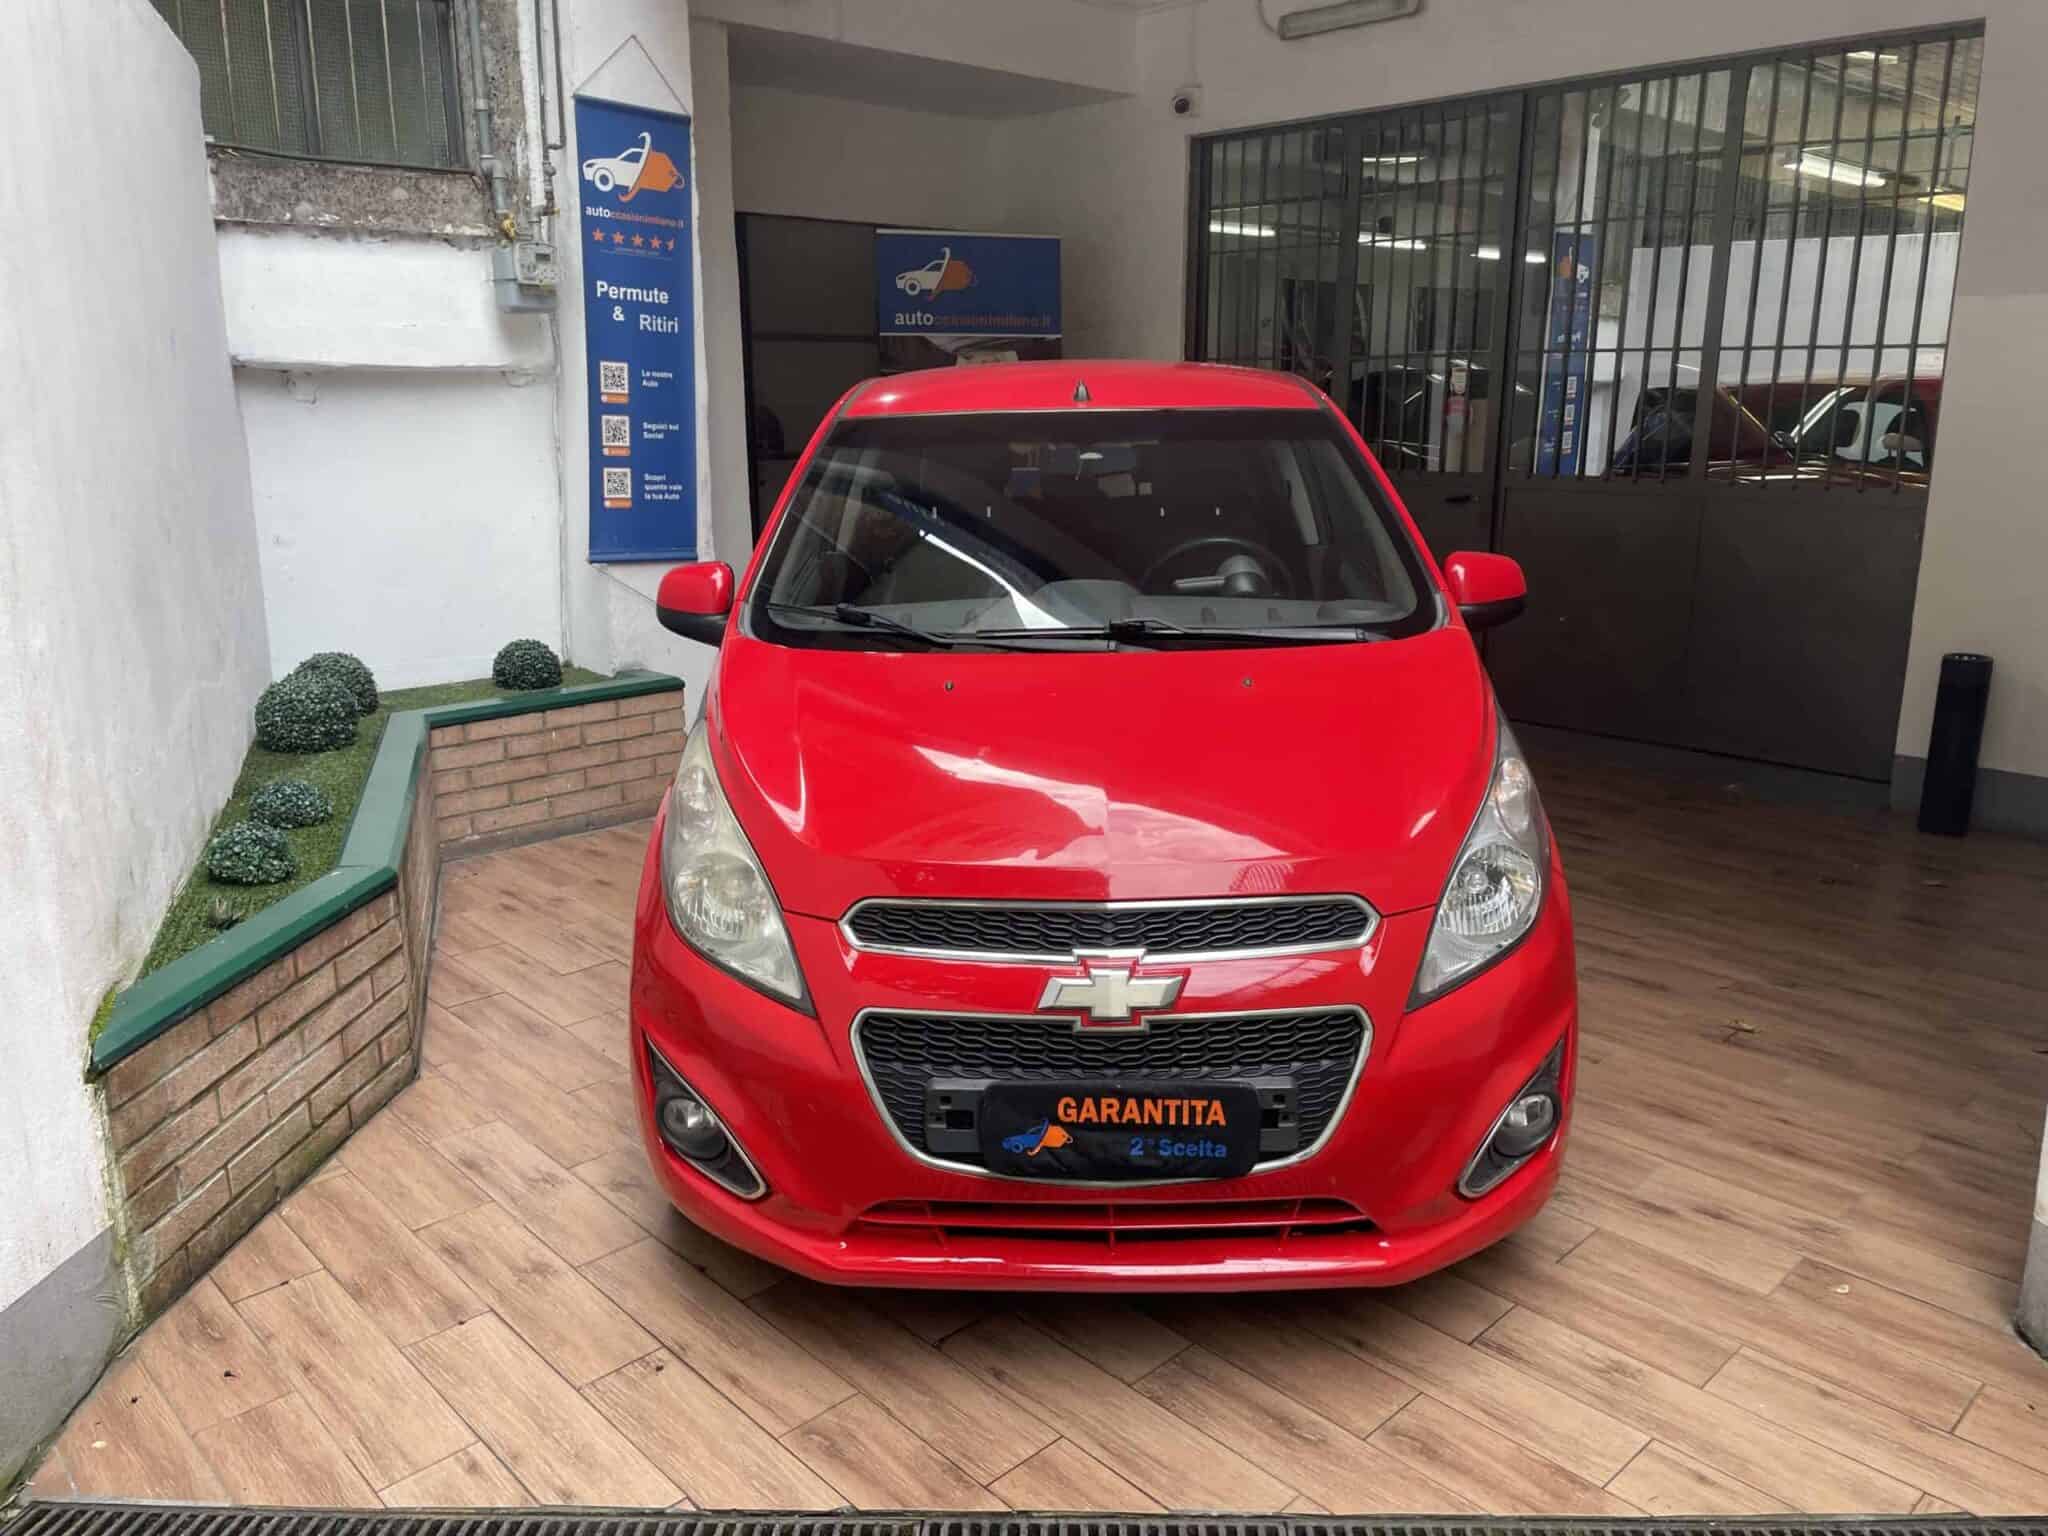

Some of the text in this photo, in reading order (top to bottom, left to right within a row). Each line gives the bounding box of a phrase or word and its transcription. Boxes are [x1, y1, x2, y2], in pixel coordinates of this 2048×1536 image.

[596, 279, 669, 304] Permute
[612, 305, 679, 334] & Ritiri
[1057, 1096, 1226, 1126] GARANTITA
[1158, 1137, 1228, 1159] Scelta
